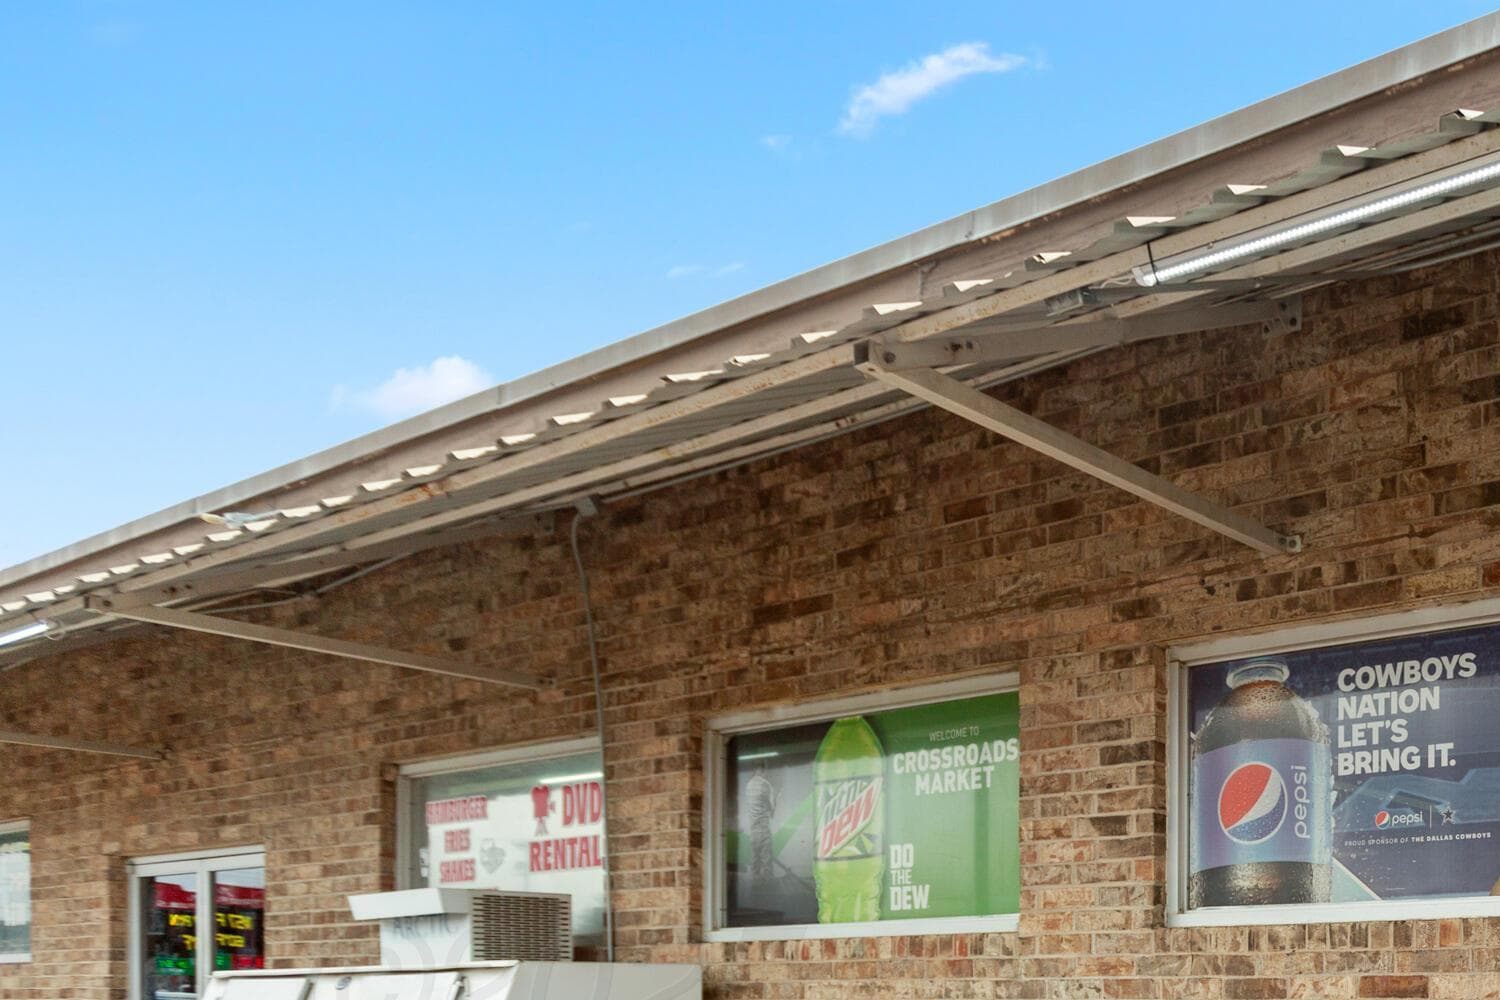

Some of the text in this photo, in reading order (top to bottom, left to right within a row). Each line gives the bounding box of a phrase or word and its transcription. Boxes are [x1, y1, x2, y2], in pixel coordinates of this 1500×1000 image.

[1337, 652, 1477, 692] COWBOYS
[1337, 686, 1440, 721] NATION
[929, 726, 980, 742] WELCOME TO
[1338, 718, 1409, 748] LET'S
[893, 738, 1019, 774] CROSSROADS
[1337, 742, 1456, 776] BRING IT.
[915, 766, 995, 796] MARKET
[562, 781, 602, 827] DVD
[1290, 765, 1310, 839] pepsi
[1391, 811, 1423, 826] pepsi
[528, 834, 603, 873] RENTAL
[1368, 838, 1398, 846] SPONSOR
[1426, 834, 1453, 842] DALLAS
[1455, 832, 1491, 840] COWBOYS
[889, 843, 914, 869] DO
[890, 869, 912, 885] THE
[889, 884, 930, 911] DEW
